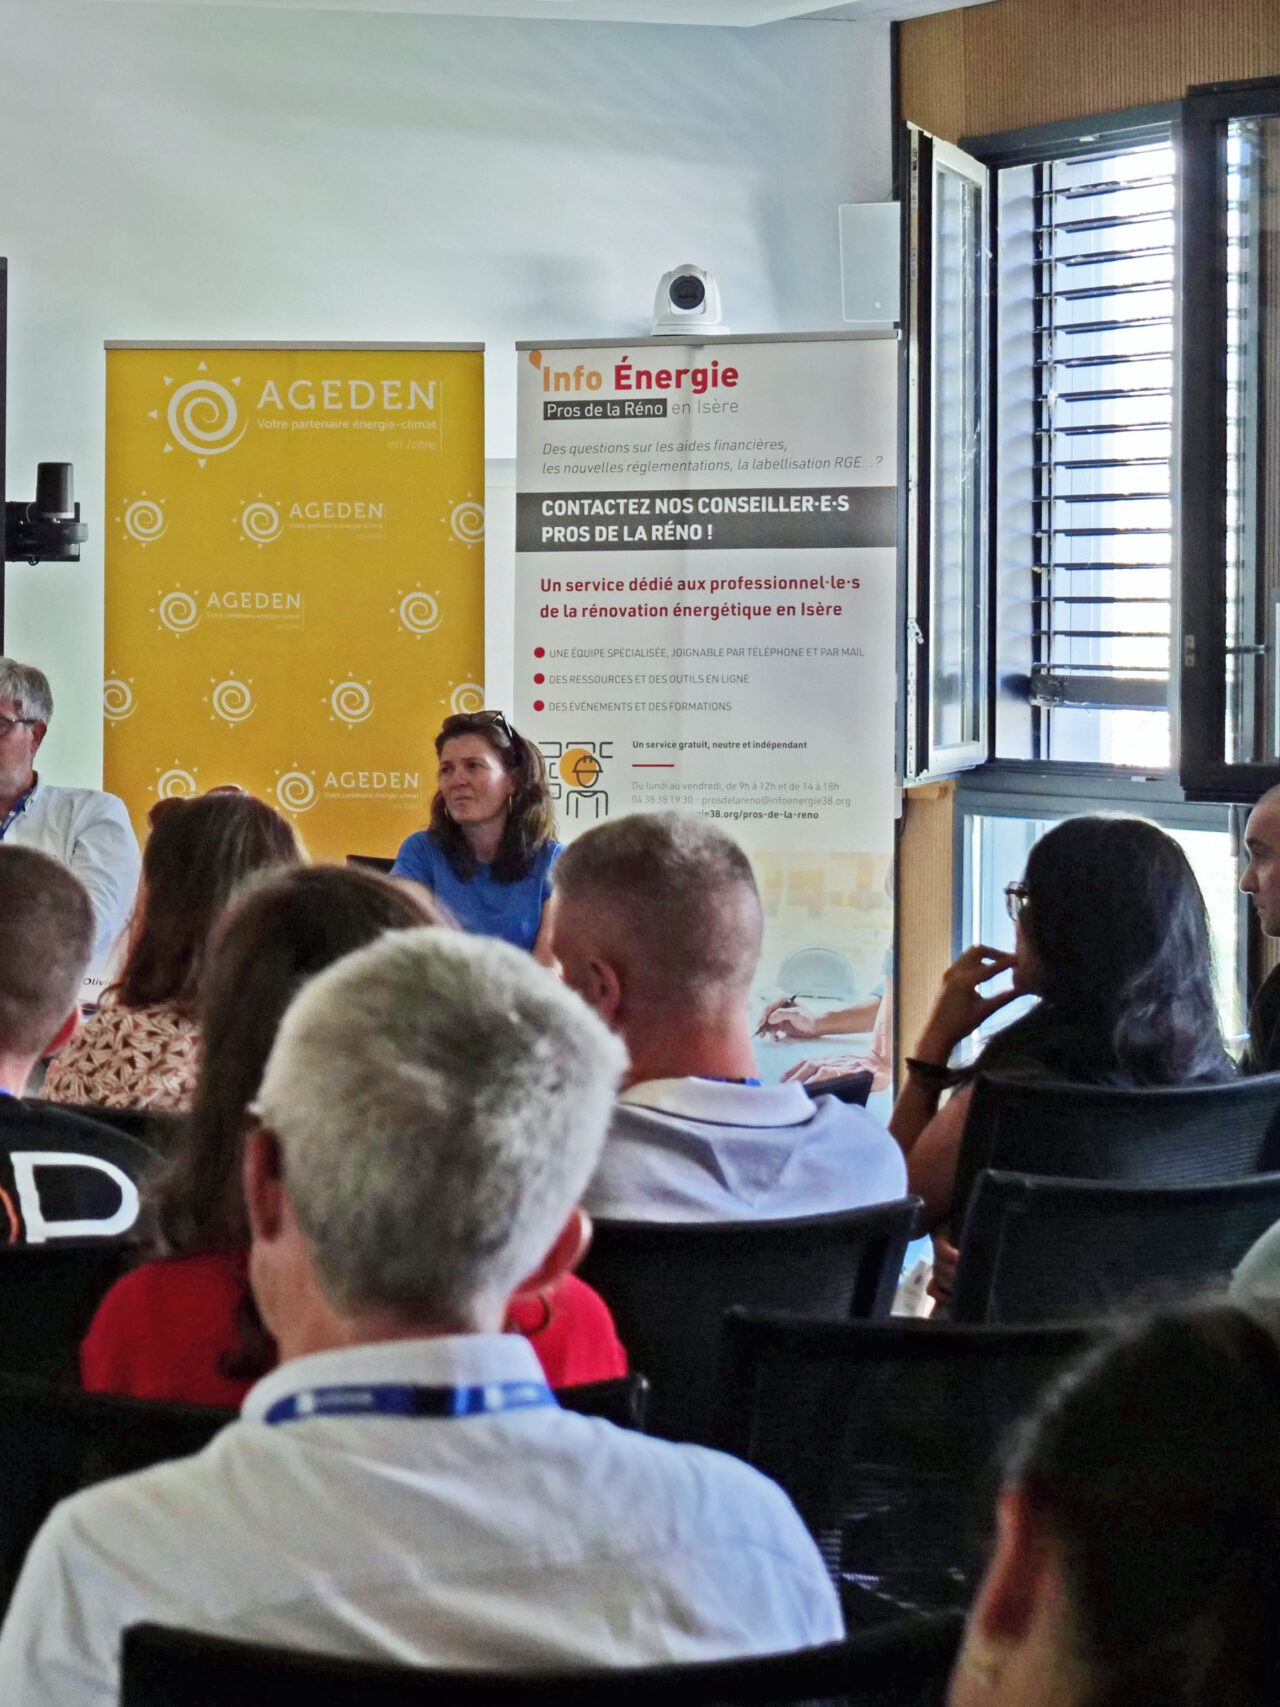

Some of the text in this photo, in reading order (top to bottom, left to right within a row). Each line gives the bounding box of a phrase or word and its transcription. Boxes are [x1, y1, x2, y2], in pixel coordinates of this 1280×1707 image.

[543, 356, 738, 394] Info Énergie
[257, 380, 436, 410] AGEDEN
[548, 397, 738, 418] Pros de la Réno en Isère
[543, 438, 787, 457] Des questions sur les aides financières,
[289, 501, 383, 519] AGEDEN
[542, 498, 650, 517] CONTACTEZ
[655, 497, 694, 515] NOS
[542, 525, 590, 543] PROS
[595, 525, 618, 542] DE
[624, 525, 647, 542] LA
[652, 519, 702, 541] RÉNO
[541, 578, 561, 593] Un
[566, 577, 624, 592] service
[629, 576, 673, 592] dédié
[677, 579, 705, 591] aux
[207, 591, 300, 610] AGEDEN
[540, 601, 842, 621] de la rénovation énergétique en Isère
[633, 740, 807, 751] Un service gratuit, neutre et indépendant
[324, 771, 419, 789] AGEDEN
